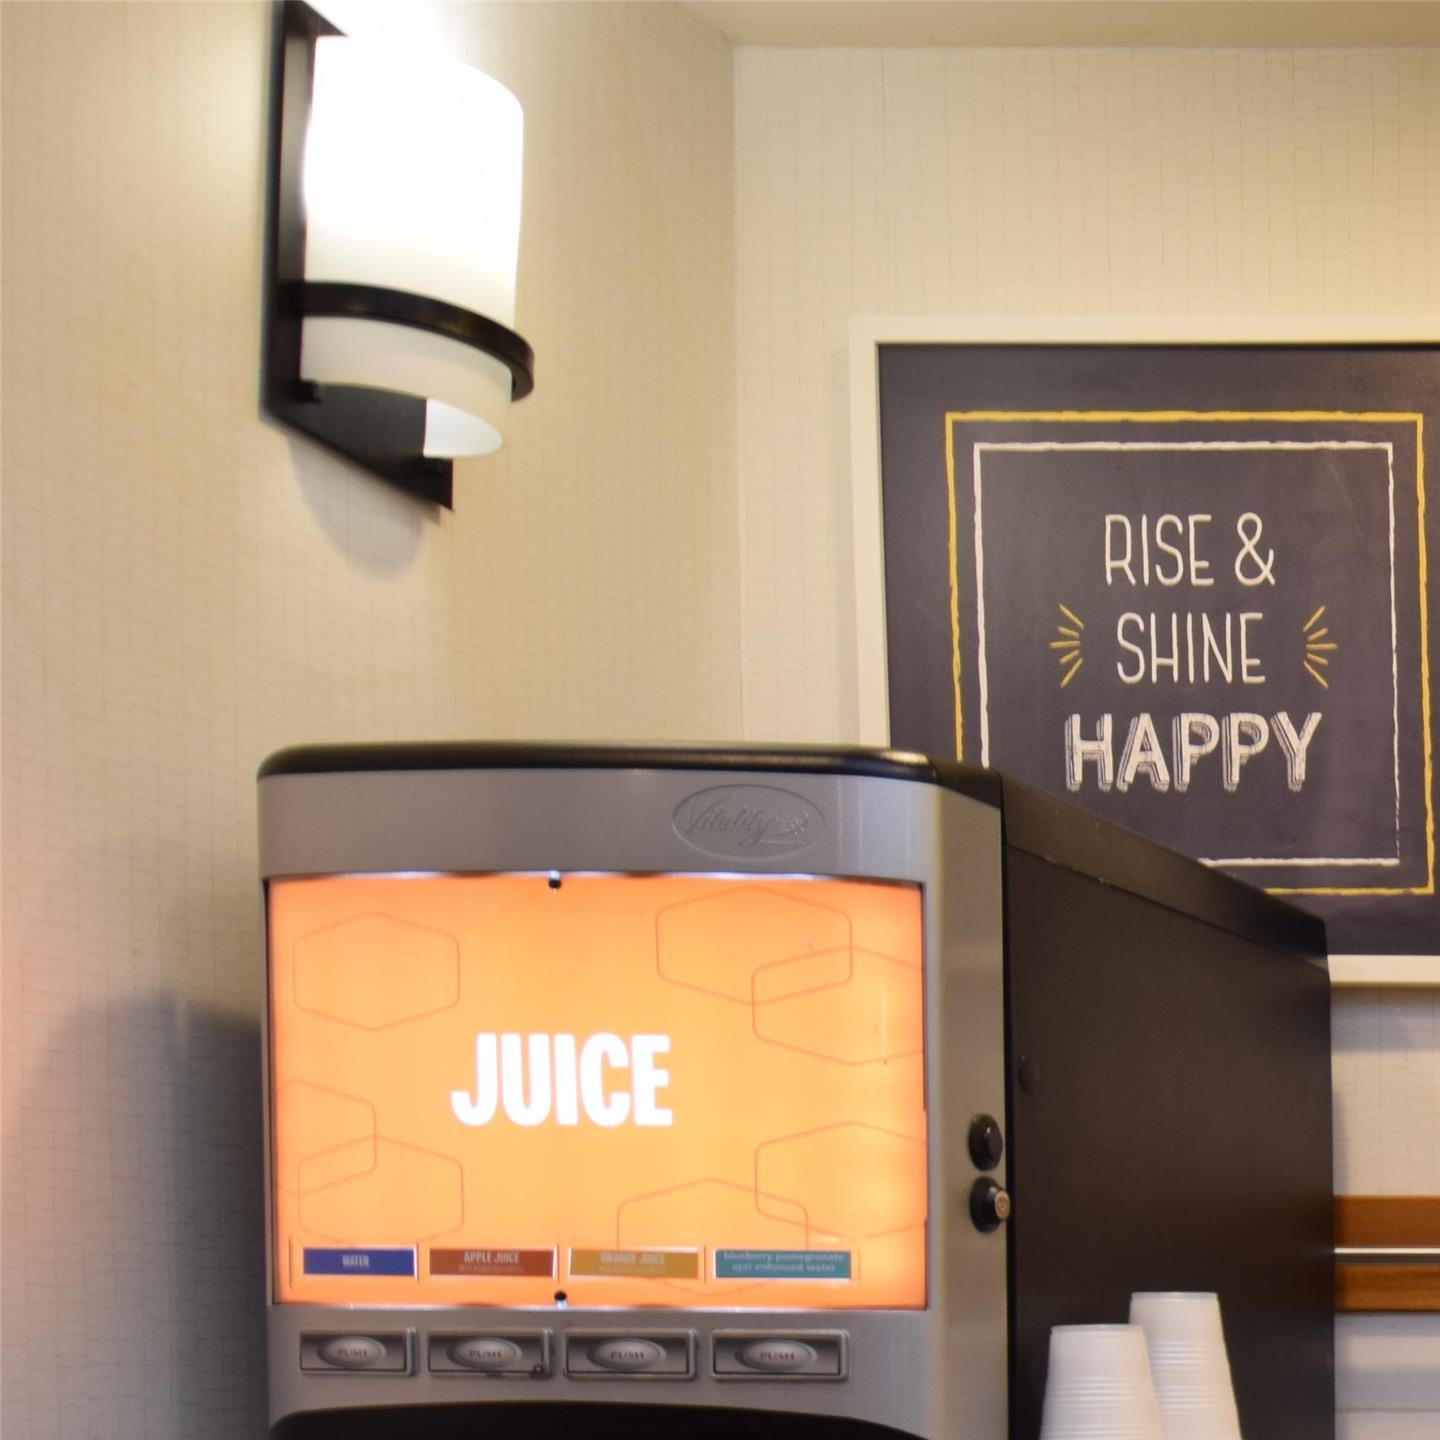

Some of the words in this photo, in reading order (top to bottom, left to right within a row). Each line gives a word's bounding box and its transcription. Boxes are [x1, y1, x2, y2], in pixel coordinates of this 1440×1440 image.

[1104, 512, 1214, 587] RISE
[1234, 511, 1276, 587] &
[1116, 611, 1266, 684] SHINE
[1065, 711, 1322, 792] HAPPY
[450, 1032, 673, 1128] JUICE
[342, 1254, 370, 1269] WATER
[463, 1251, 491, 1264] APPLE
[494, 1251, 519, 1264] JUICE
[723, 1251, 772, 1265] blueberry
[775, 1252, 844, 1264] pomegranate
[806, 1263, 836, 1273] water
[611, 1350, 645, 1360] PUSH
[760, 1351, 795, 1361] PUSH
